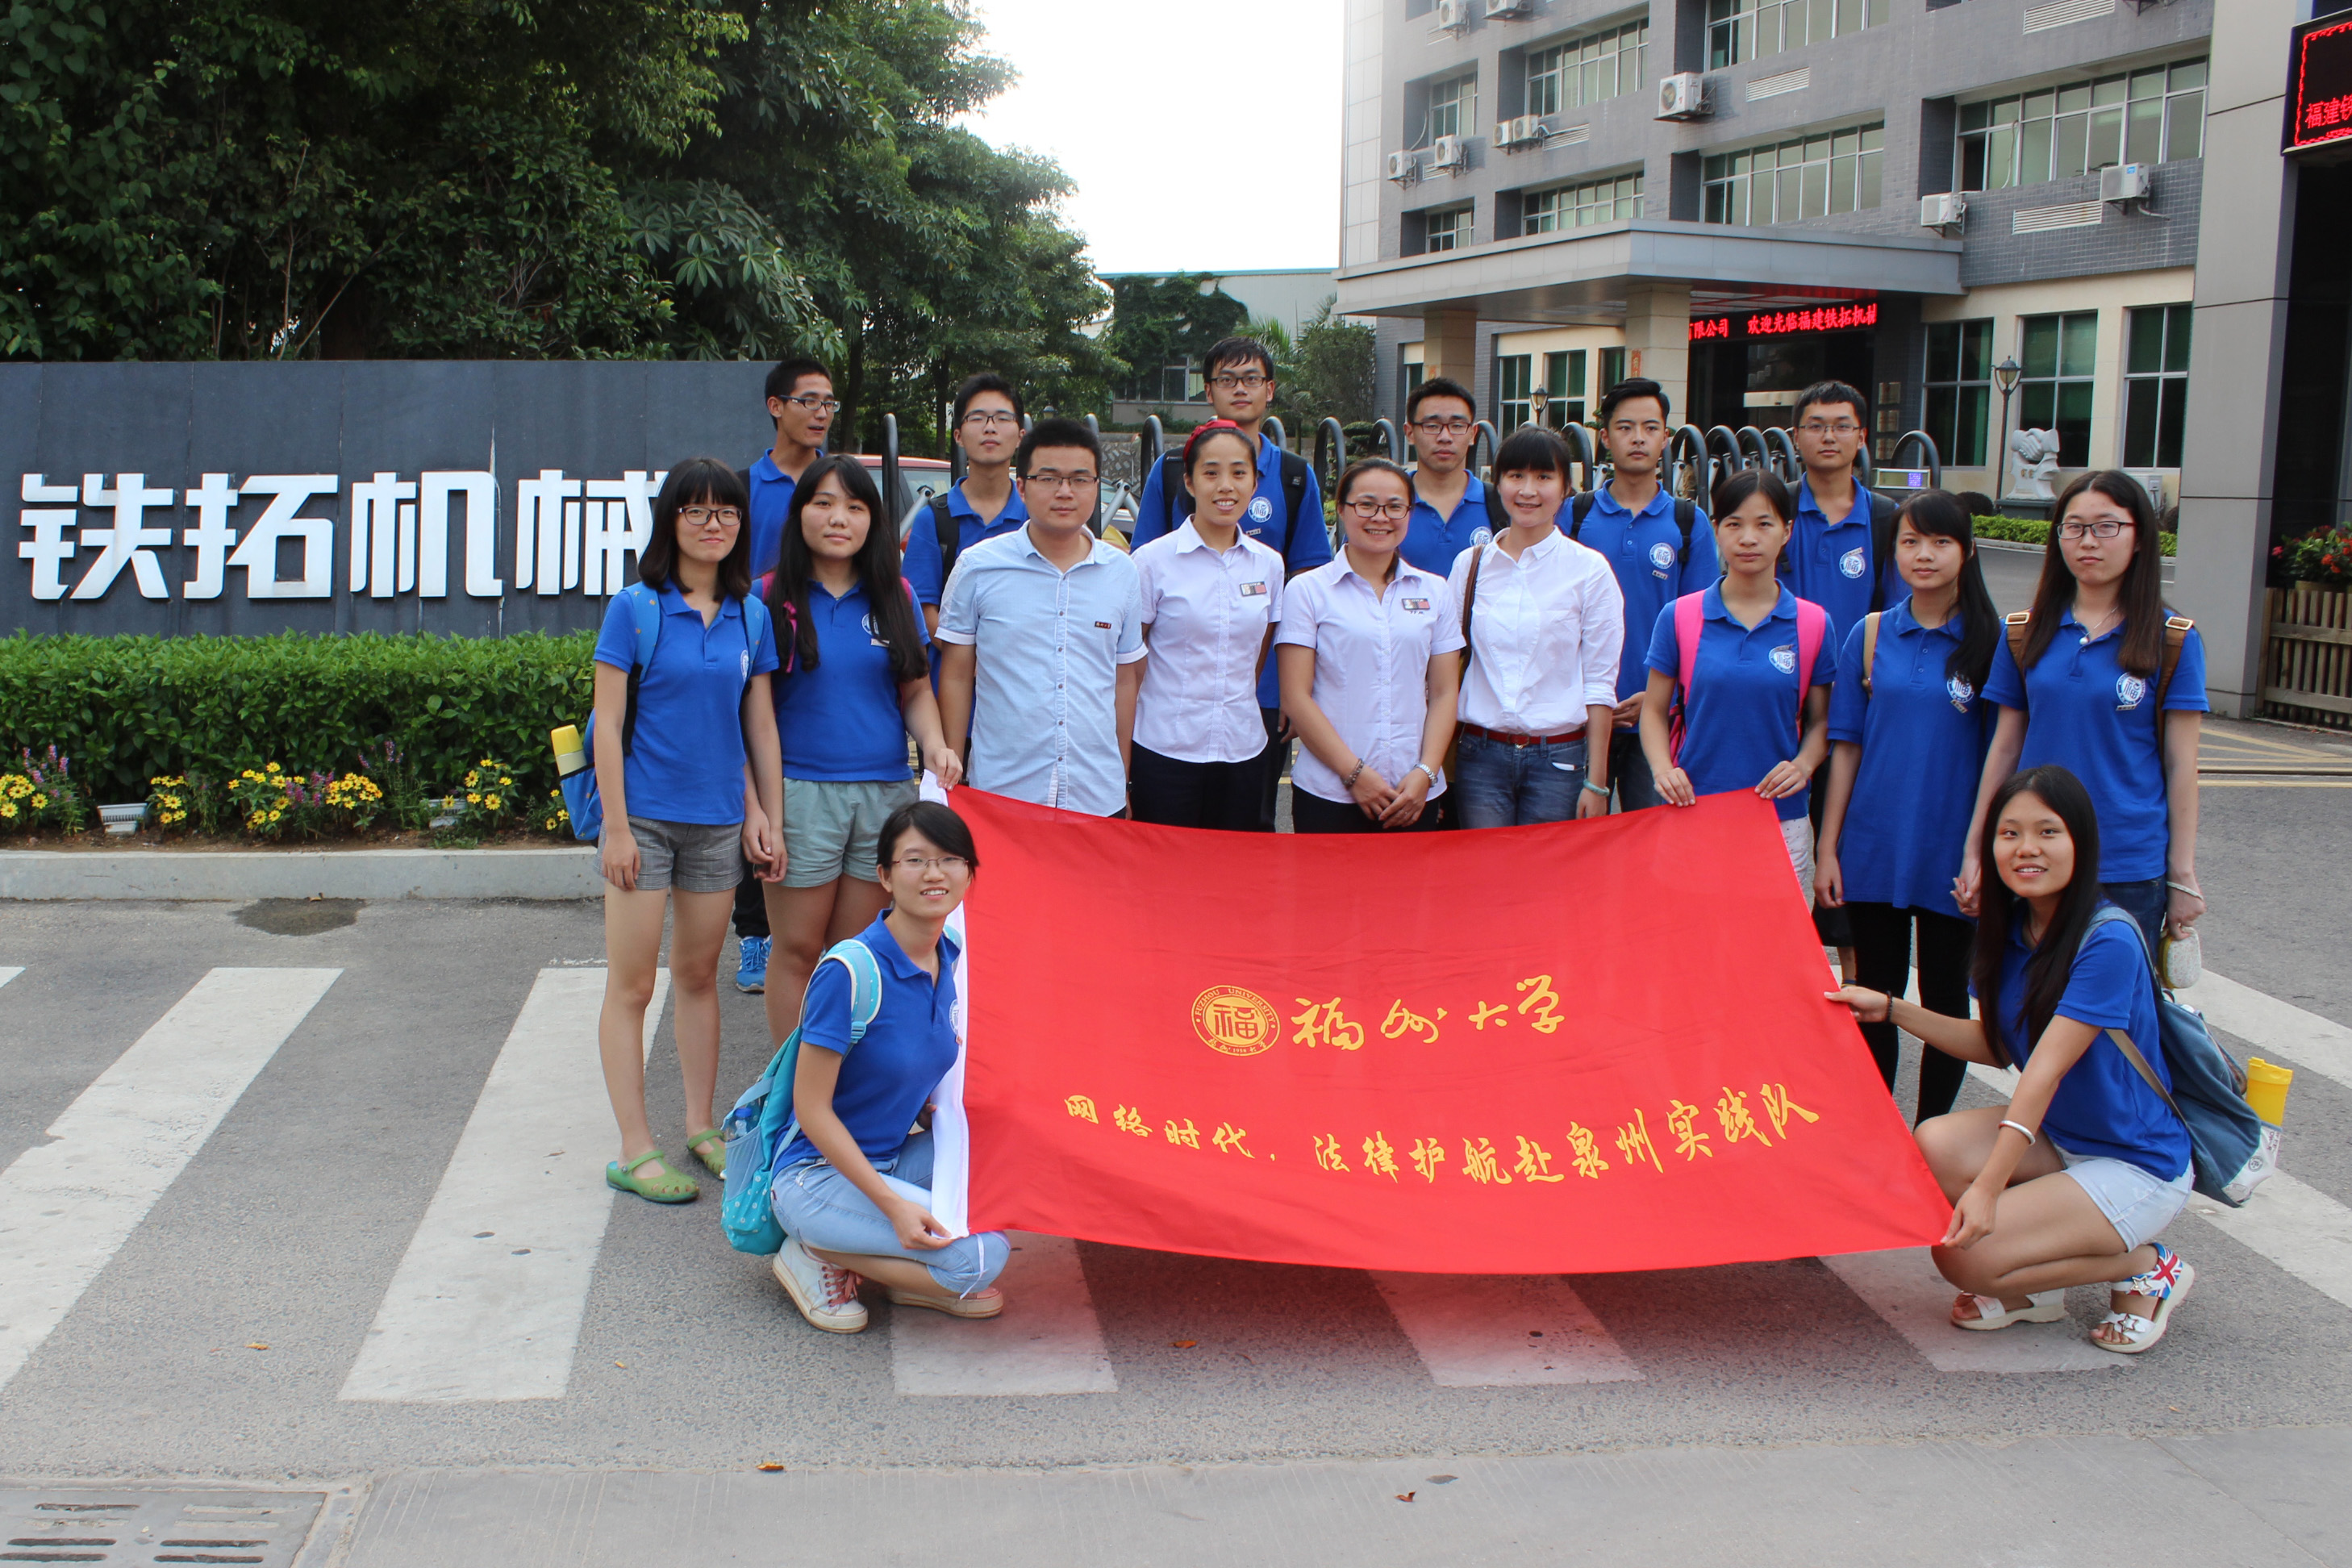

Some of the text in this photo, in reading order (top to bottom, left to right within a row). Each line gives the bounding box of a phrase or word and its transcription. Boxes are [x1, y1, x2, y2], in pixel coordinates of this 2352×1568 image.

[19, 469, 669, 600] 铁拓机械
[1195, 988, 1277, 1023] FUZHOU UNIVERSITY
[1211, 1003, 1260, 1040] 福
[1291, 974, 1565, 1051] 福州大学
